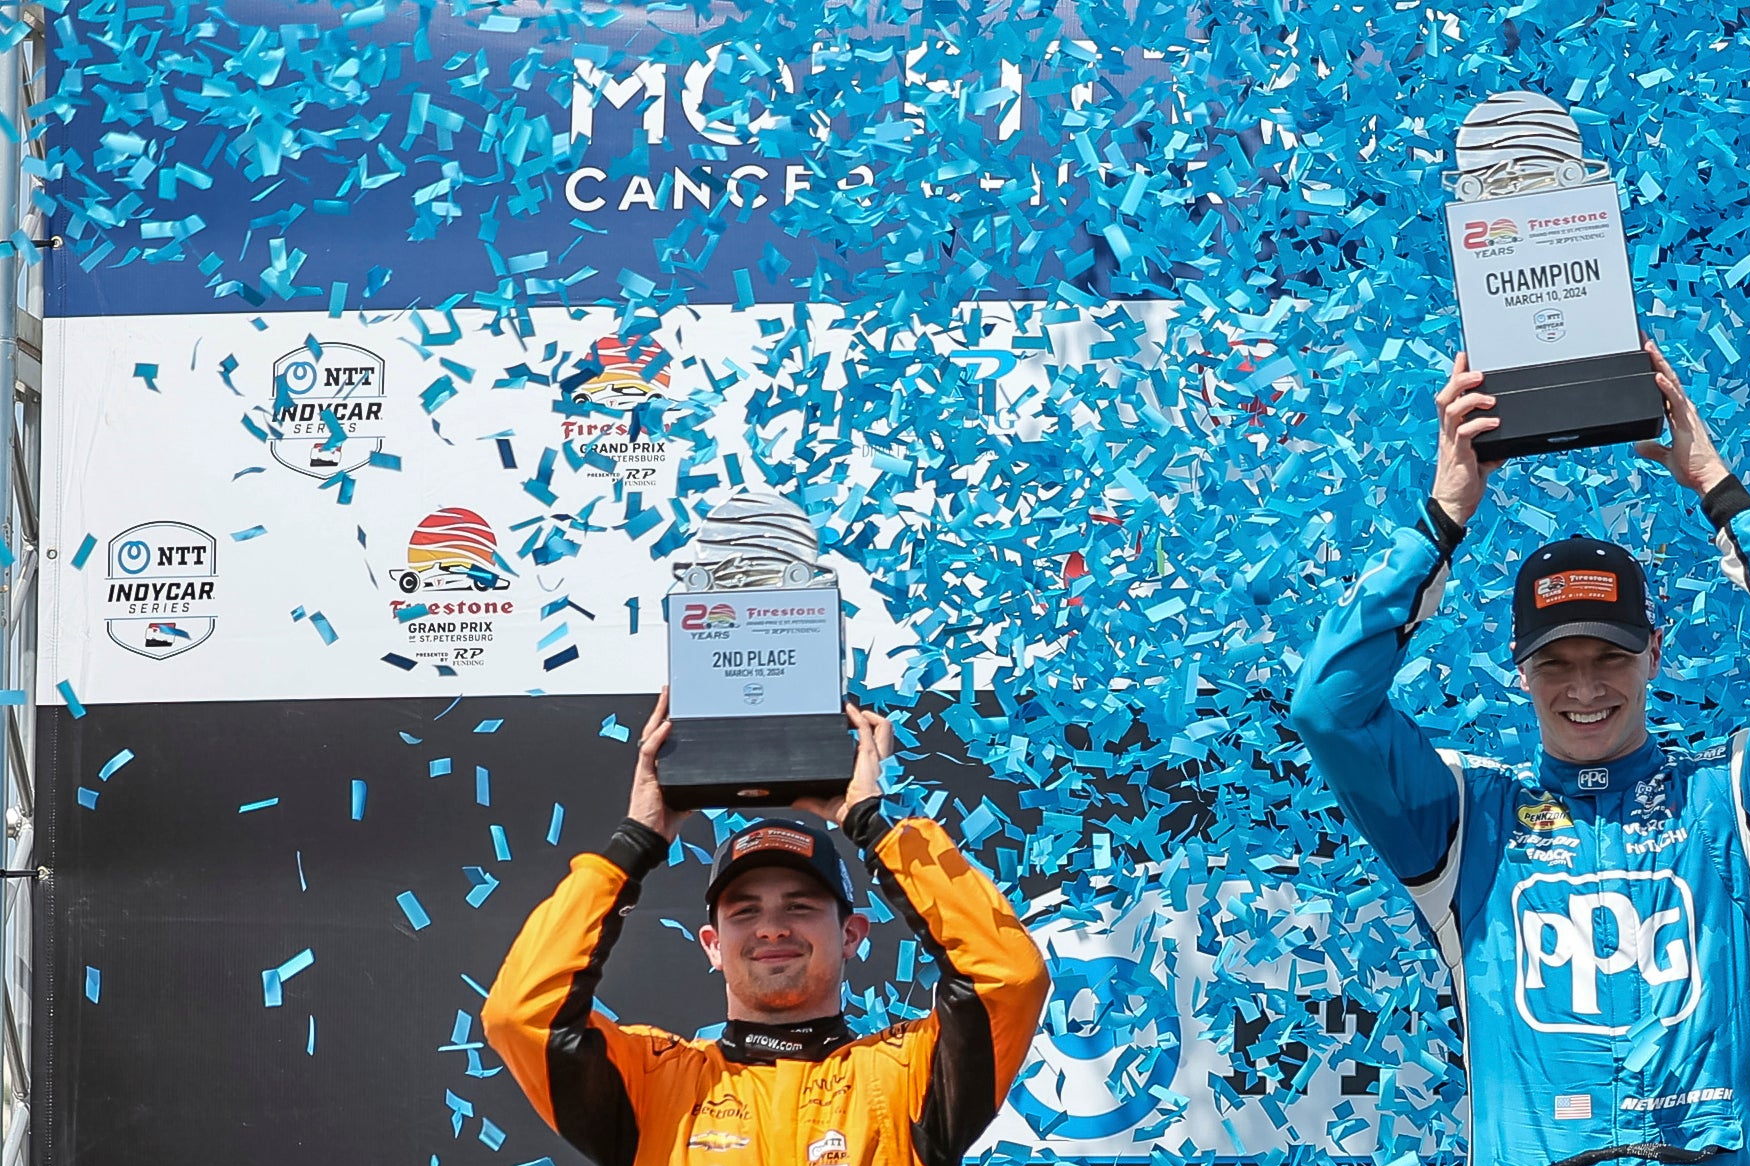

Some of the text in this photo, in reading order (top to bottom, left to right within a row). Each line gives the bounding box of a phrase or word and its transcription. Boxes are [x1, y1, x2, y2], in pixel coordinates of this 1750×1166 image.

[1527, 211, 1609, 232] Firestone
[1474, 245, 1515, 259] YEARS
[1485, 258, 1601, 296] CHAMPION
[1504, 286, 1588, 308] MARCH 10, 2024
[324, 367, 375, 386] NTT
[293, 423, 357, 434] SERS
[580, 442, 665, 454] GRAND PRIX
[625, 468, 657, 479] RP
[157, 546, 207, 566] NTT
[107, 582, 215, 602] INDYCAR
[128, 602, 190, 614] SERIES
[389, 600, 514, 619] Festone
[746, 607, 827, 619] Firestone
[408, 621, 493, 634] GRAND PRIX
[690, 631, 731, 640] YEARS
[453, 648, 485, 659] RP
[712, 649, 797, 669] 2ND PLACE
[1580, 771, 1607, 787] PPG
[1522, 890, 1690, 1015] PPG
[745, 1033, 803, 1051] arrow.com
[1619, 1087, 1734, 1113] NEWGARDEN
